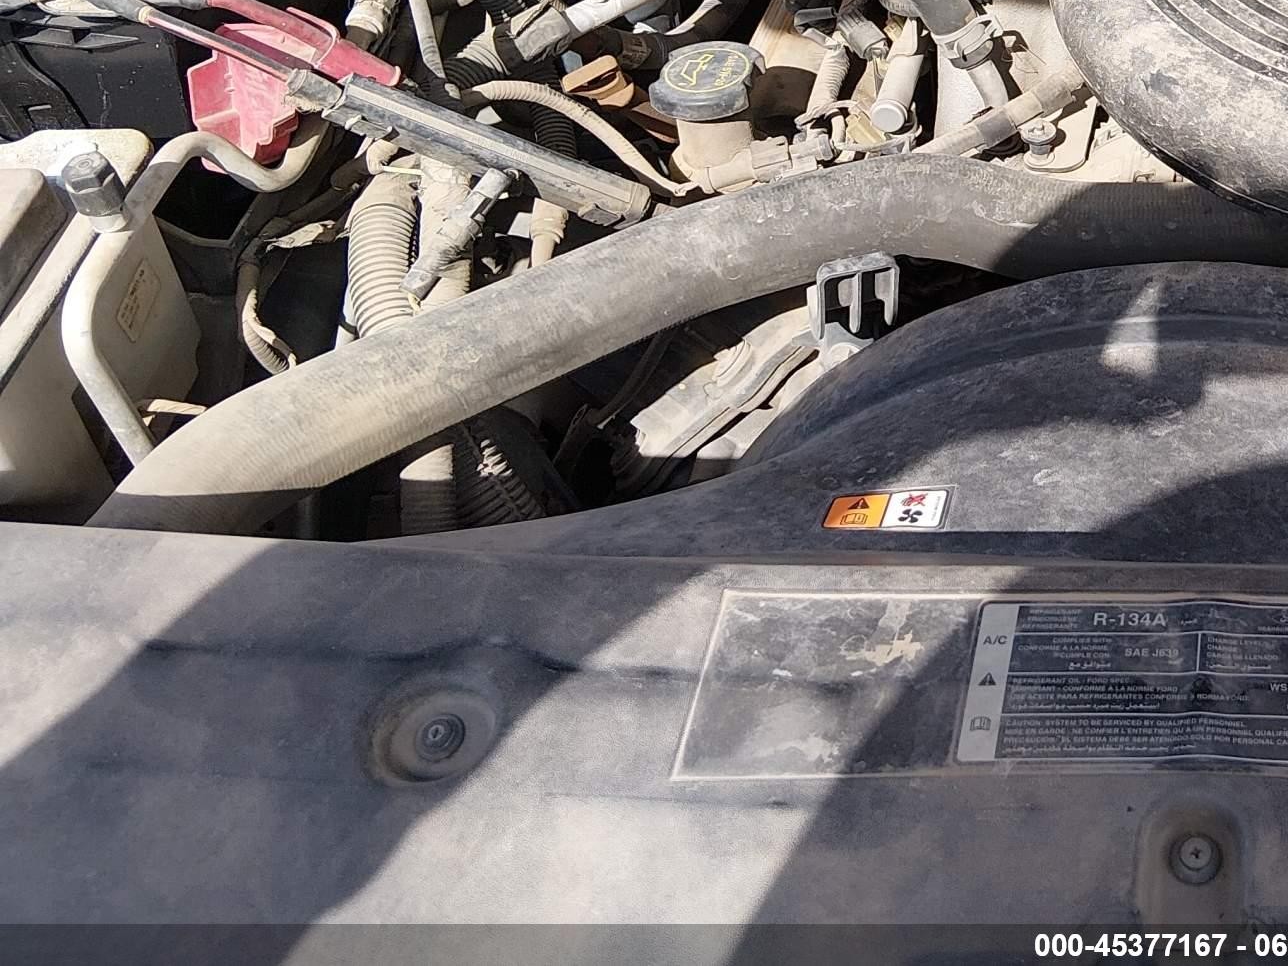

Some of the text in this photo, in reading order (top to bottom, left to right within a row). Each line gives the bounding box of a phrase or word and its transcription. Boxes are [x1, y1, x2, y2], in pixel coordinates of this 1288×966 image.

[1092, 611, 1167, 627] R-134A
[983, 634, 1008, 645] A/C
[1124, 647, 1180, 659] SAE J639
